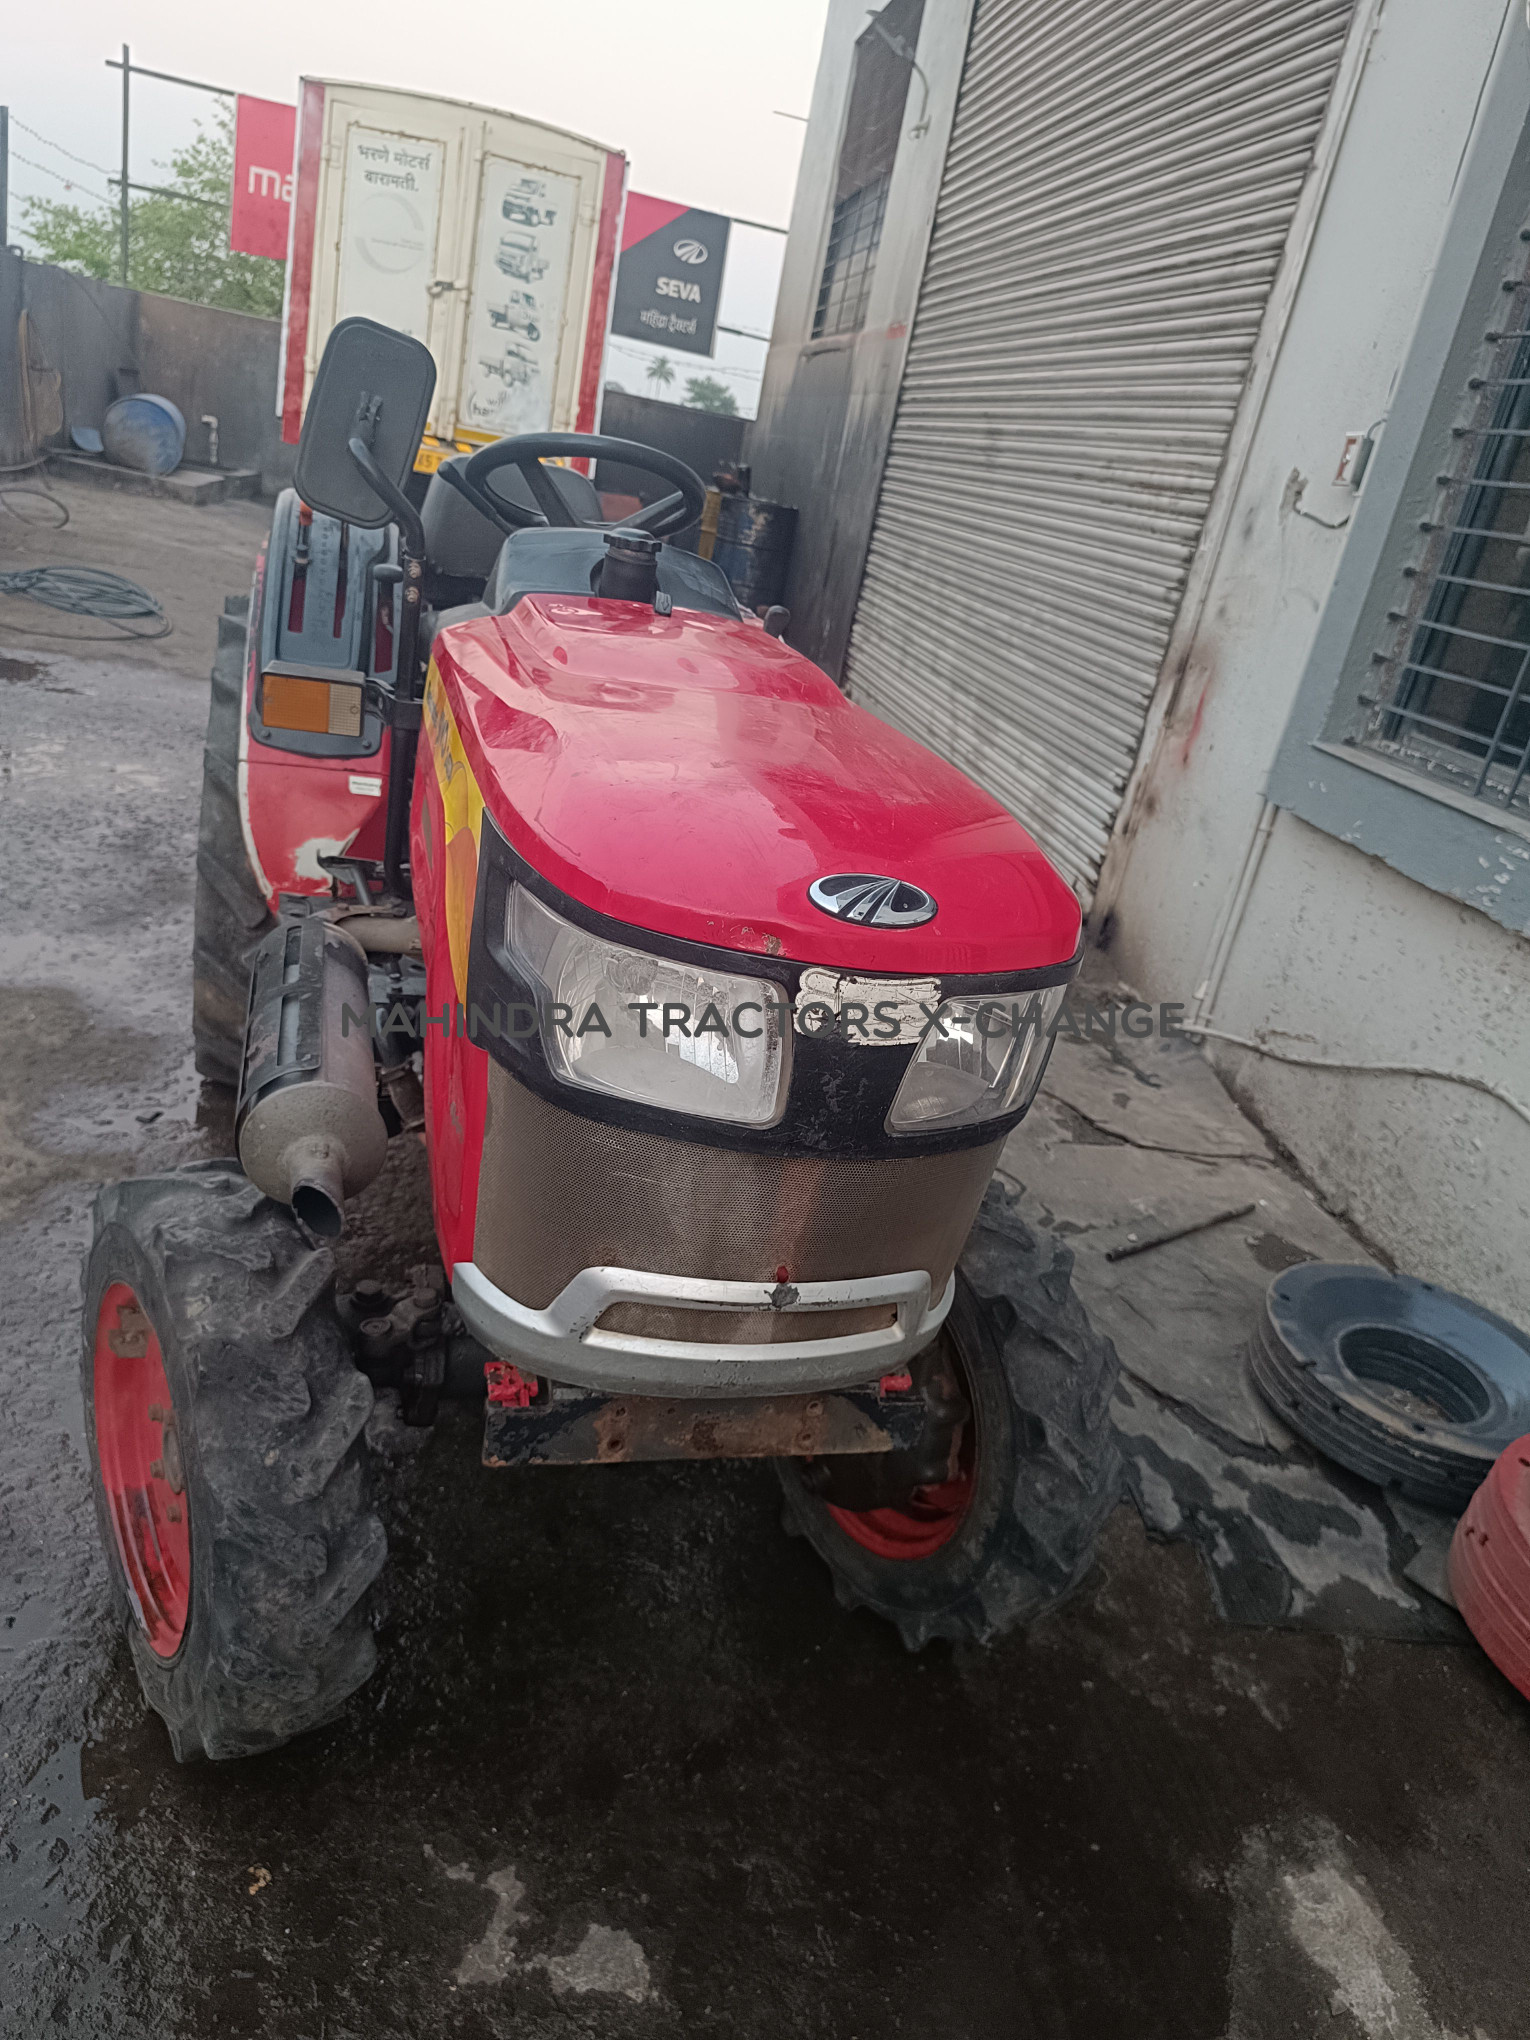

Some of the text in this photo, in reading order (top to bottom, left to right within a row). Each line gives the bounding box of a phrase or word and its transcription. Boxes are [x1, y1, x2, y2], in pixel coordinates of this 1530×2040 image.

[357, 144, 432, 171] भरणे मोटर्स
[655, 276, 701, 303] SEVA
